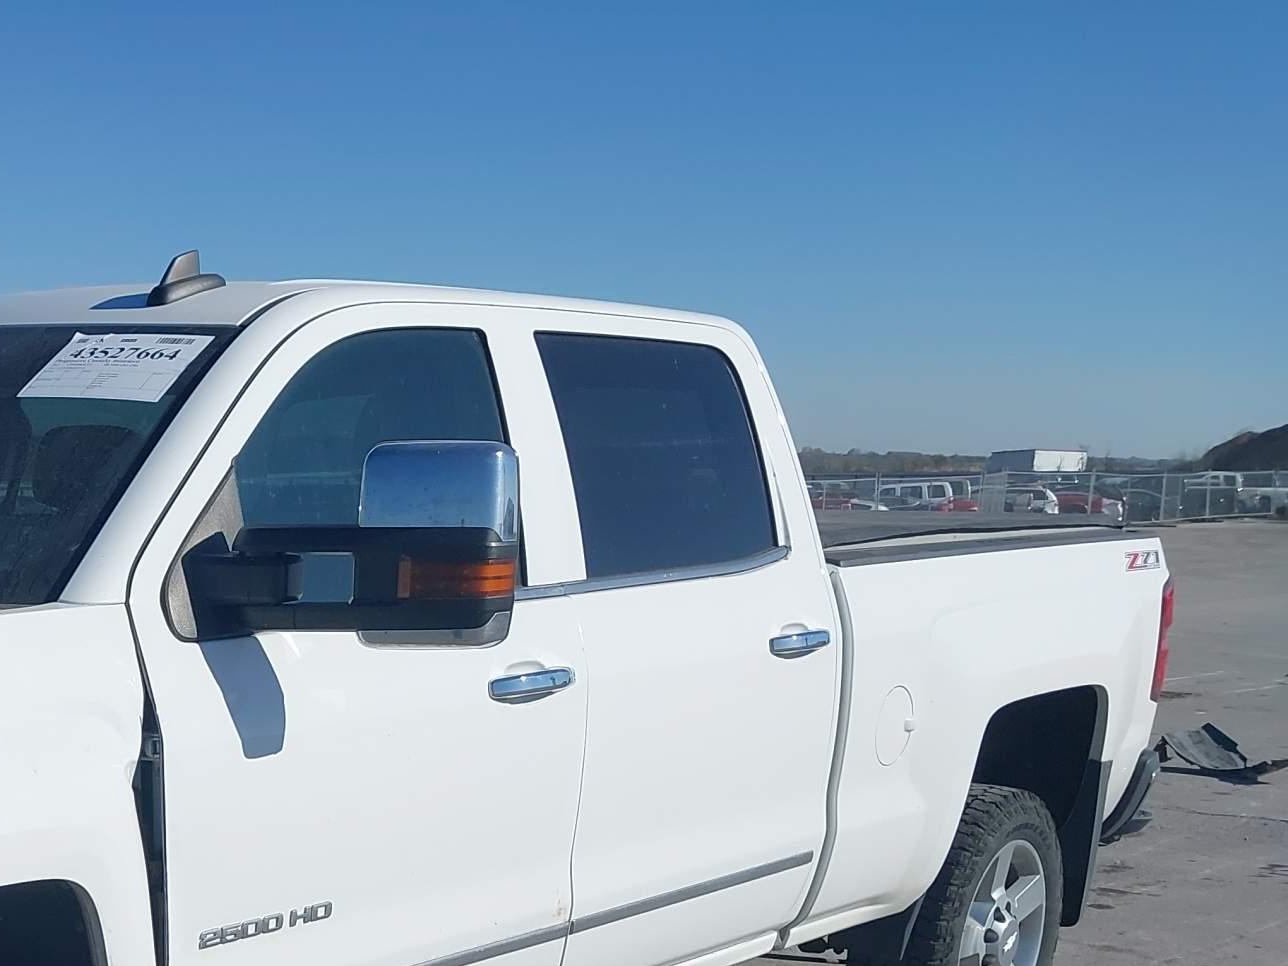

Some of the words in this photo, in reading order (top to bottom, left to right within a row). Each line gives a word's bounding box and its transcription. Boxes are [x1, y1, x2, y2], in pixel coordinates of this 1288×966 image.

[70, 347, 181, 360] 43527664
[1124, 550, 1161, 571] Z71
[198, 912, 284, 950] 2500
[289, 901, 333, 927] HD
